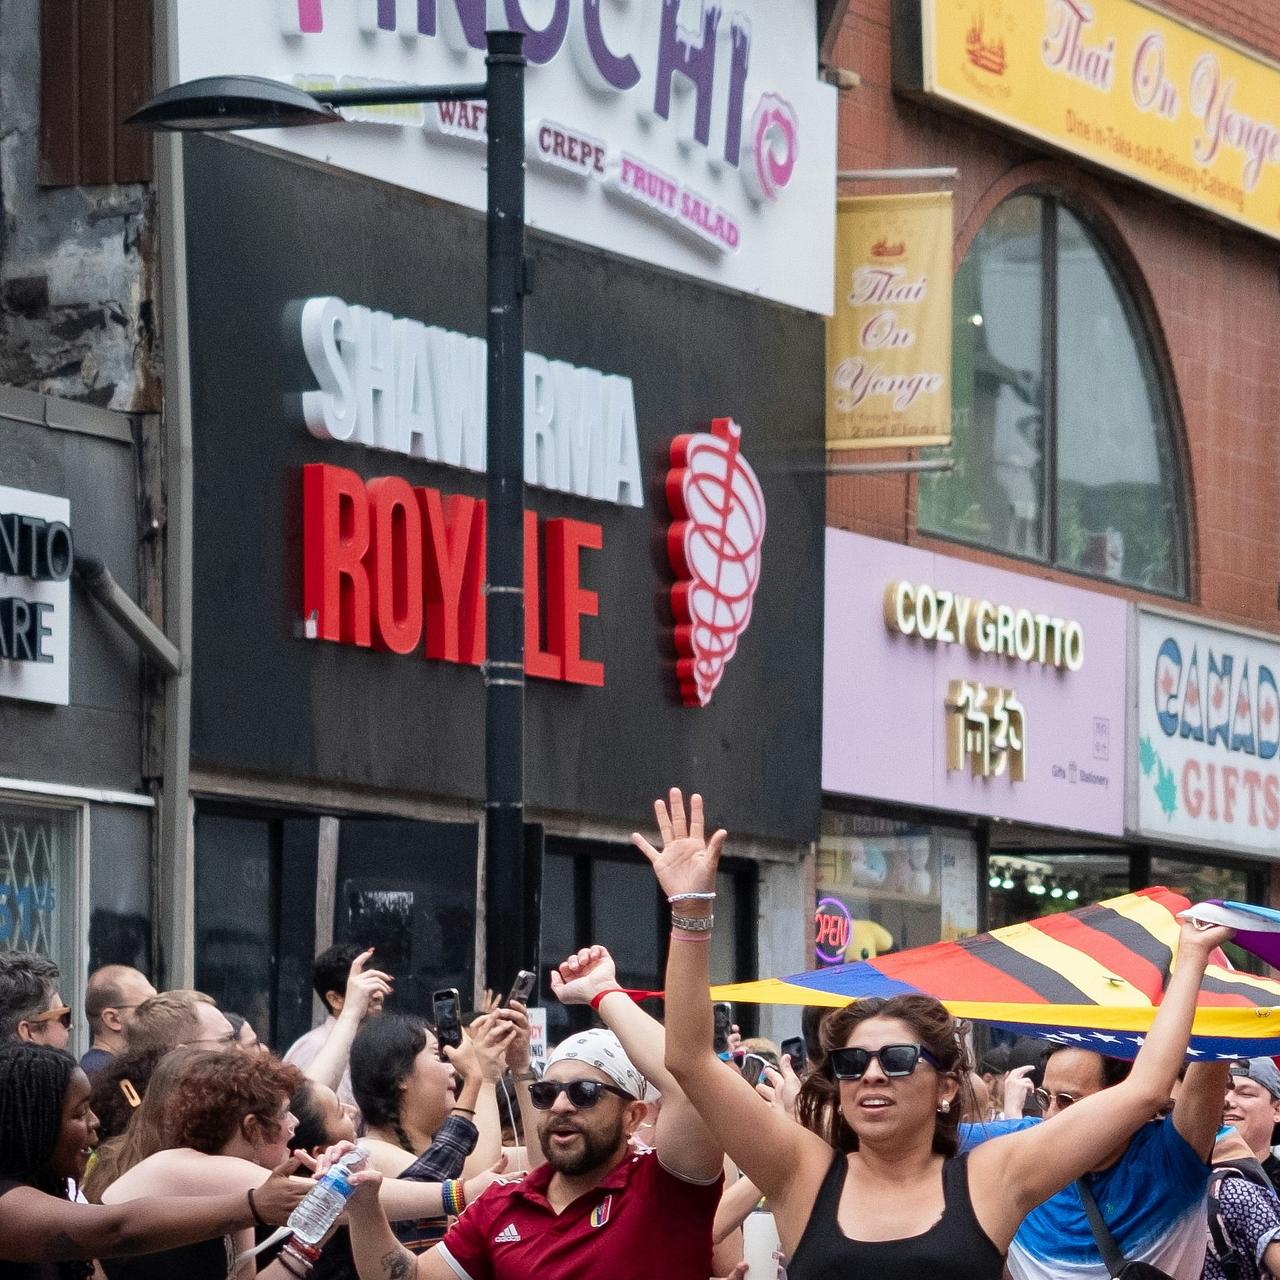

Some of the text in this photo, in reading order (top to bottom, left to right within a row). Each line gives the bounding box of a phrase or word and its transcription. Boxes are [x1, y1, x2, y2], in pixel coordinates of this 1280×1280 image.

[538, 124, 606, 176] CREPE
[621, 156, 681, 208] FRUIT
[679, 192, 742, 250] SALAD
[848, 266, 928, 307] Thai
[860, 310, 915, 351] On
[301, 297, 645, 508] SHAWRMA
[832, 356, 944, 412] Yonge
[303, 463, 606, 688] ROYLE
[0, 597, 55, 664] RE
[884, 579, 1085, 672] COZY GROTTO
[816, 913, 848, 946] OPEN
